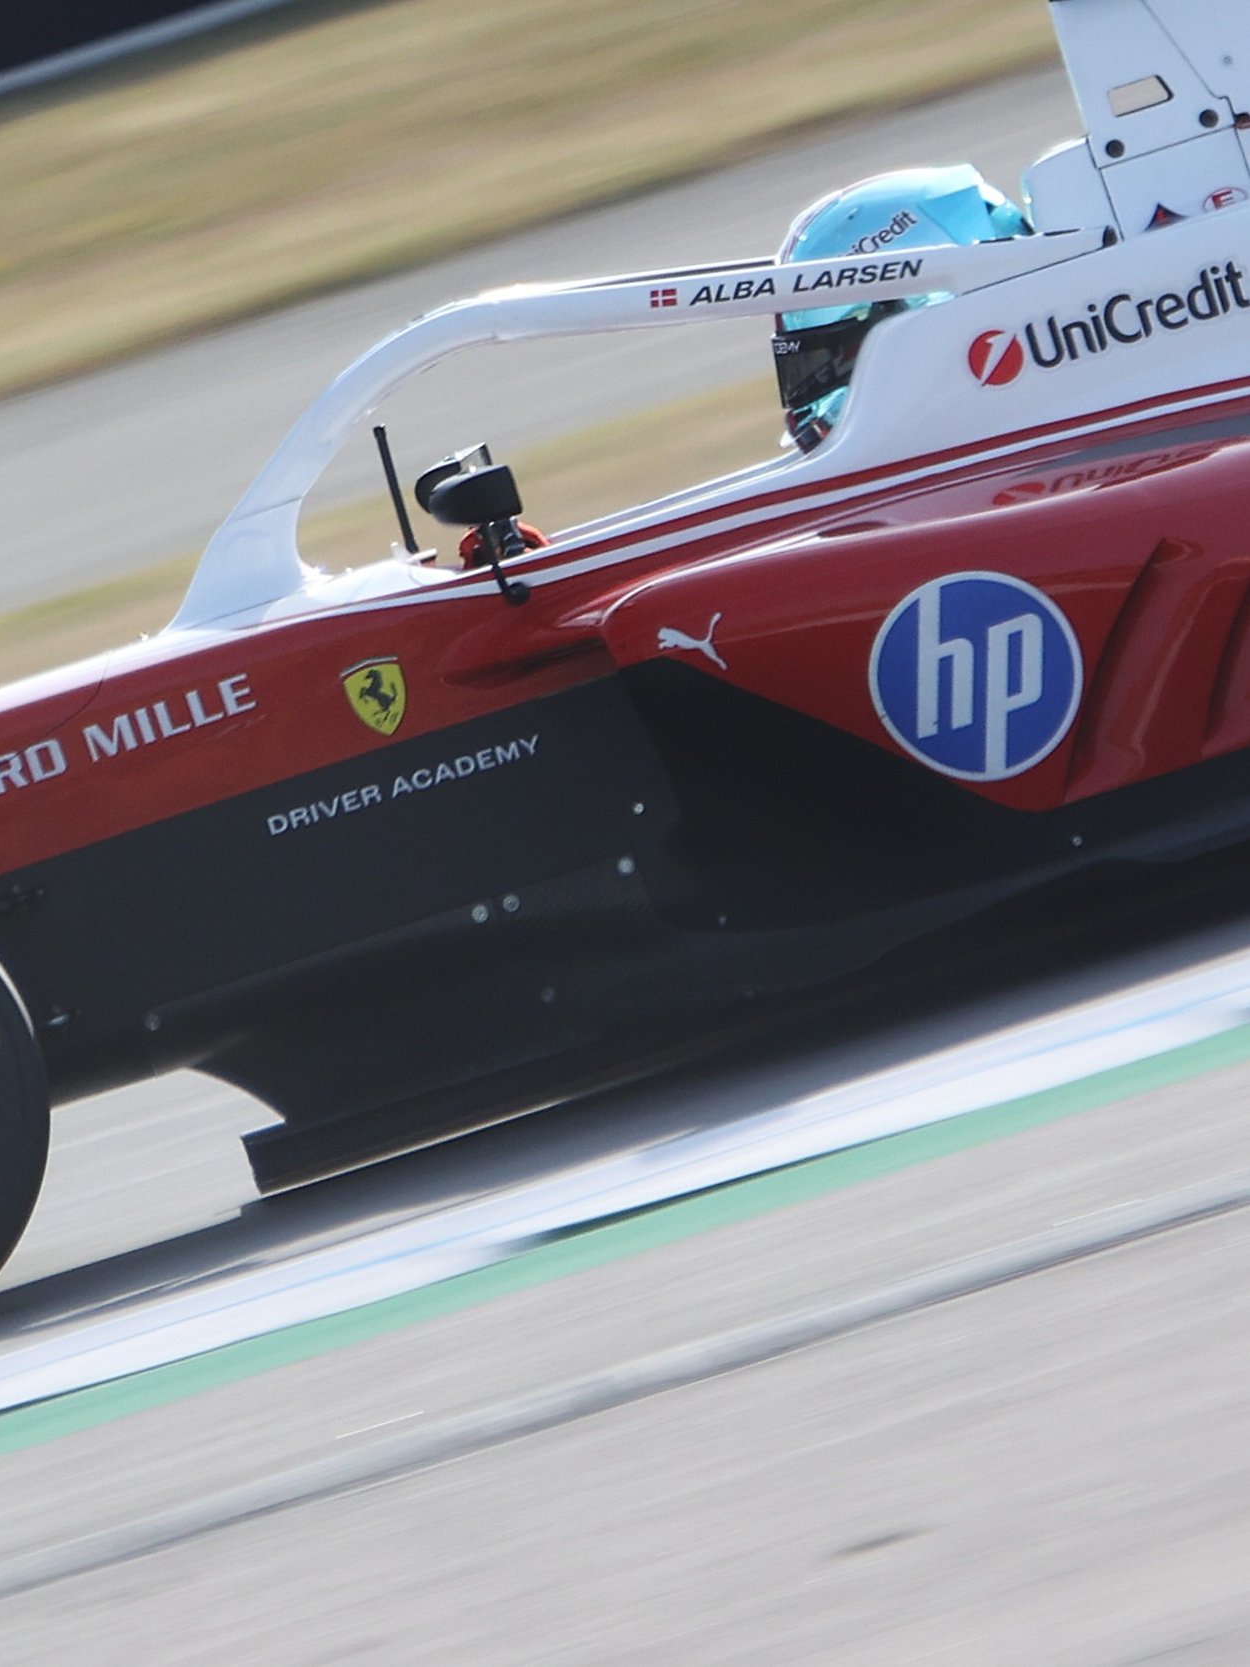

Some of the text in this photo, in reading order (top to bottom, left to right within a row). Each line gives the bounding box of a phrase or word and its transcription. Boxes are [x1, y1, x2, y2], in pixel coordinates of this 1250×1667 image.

[689, 258, 923, 306] ALBA LARSEN
[1025, 261, 1250, 369] UniCredit
[82, 672, 257, 763] MILLE
[916, 585, 1043, 774] hp
[266, 734, 541, 836] DRIVER ACADEMY
